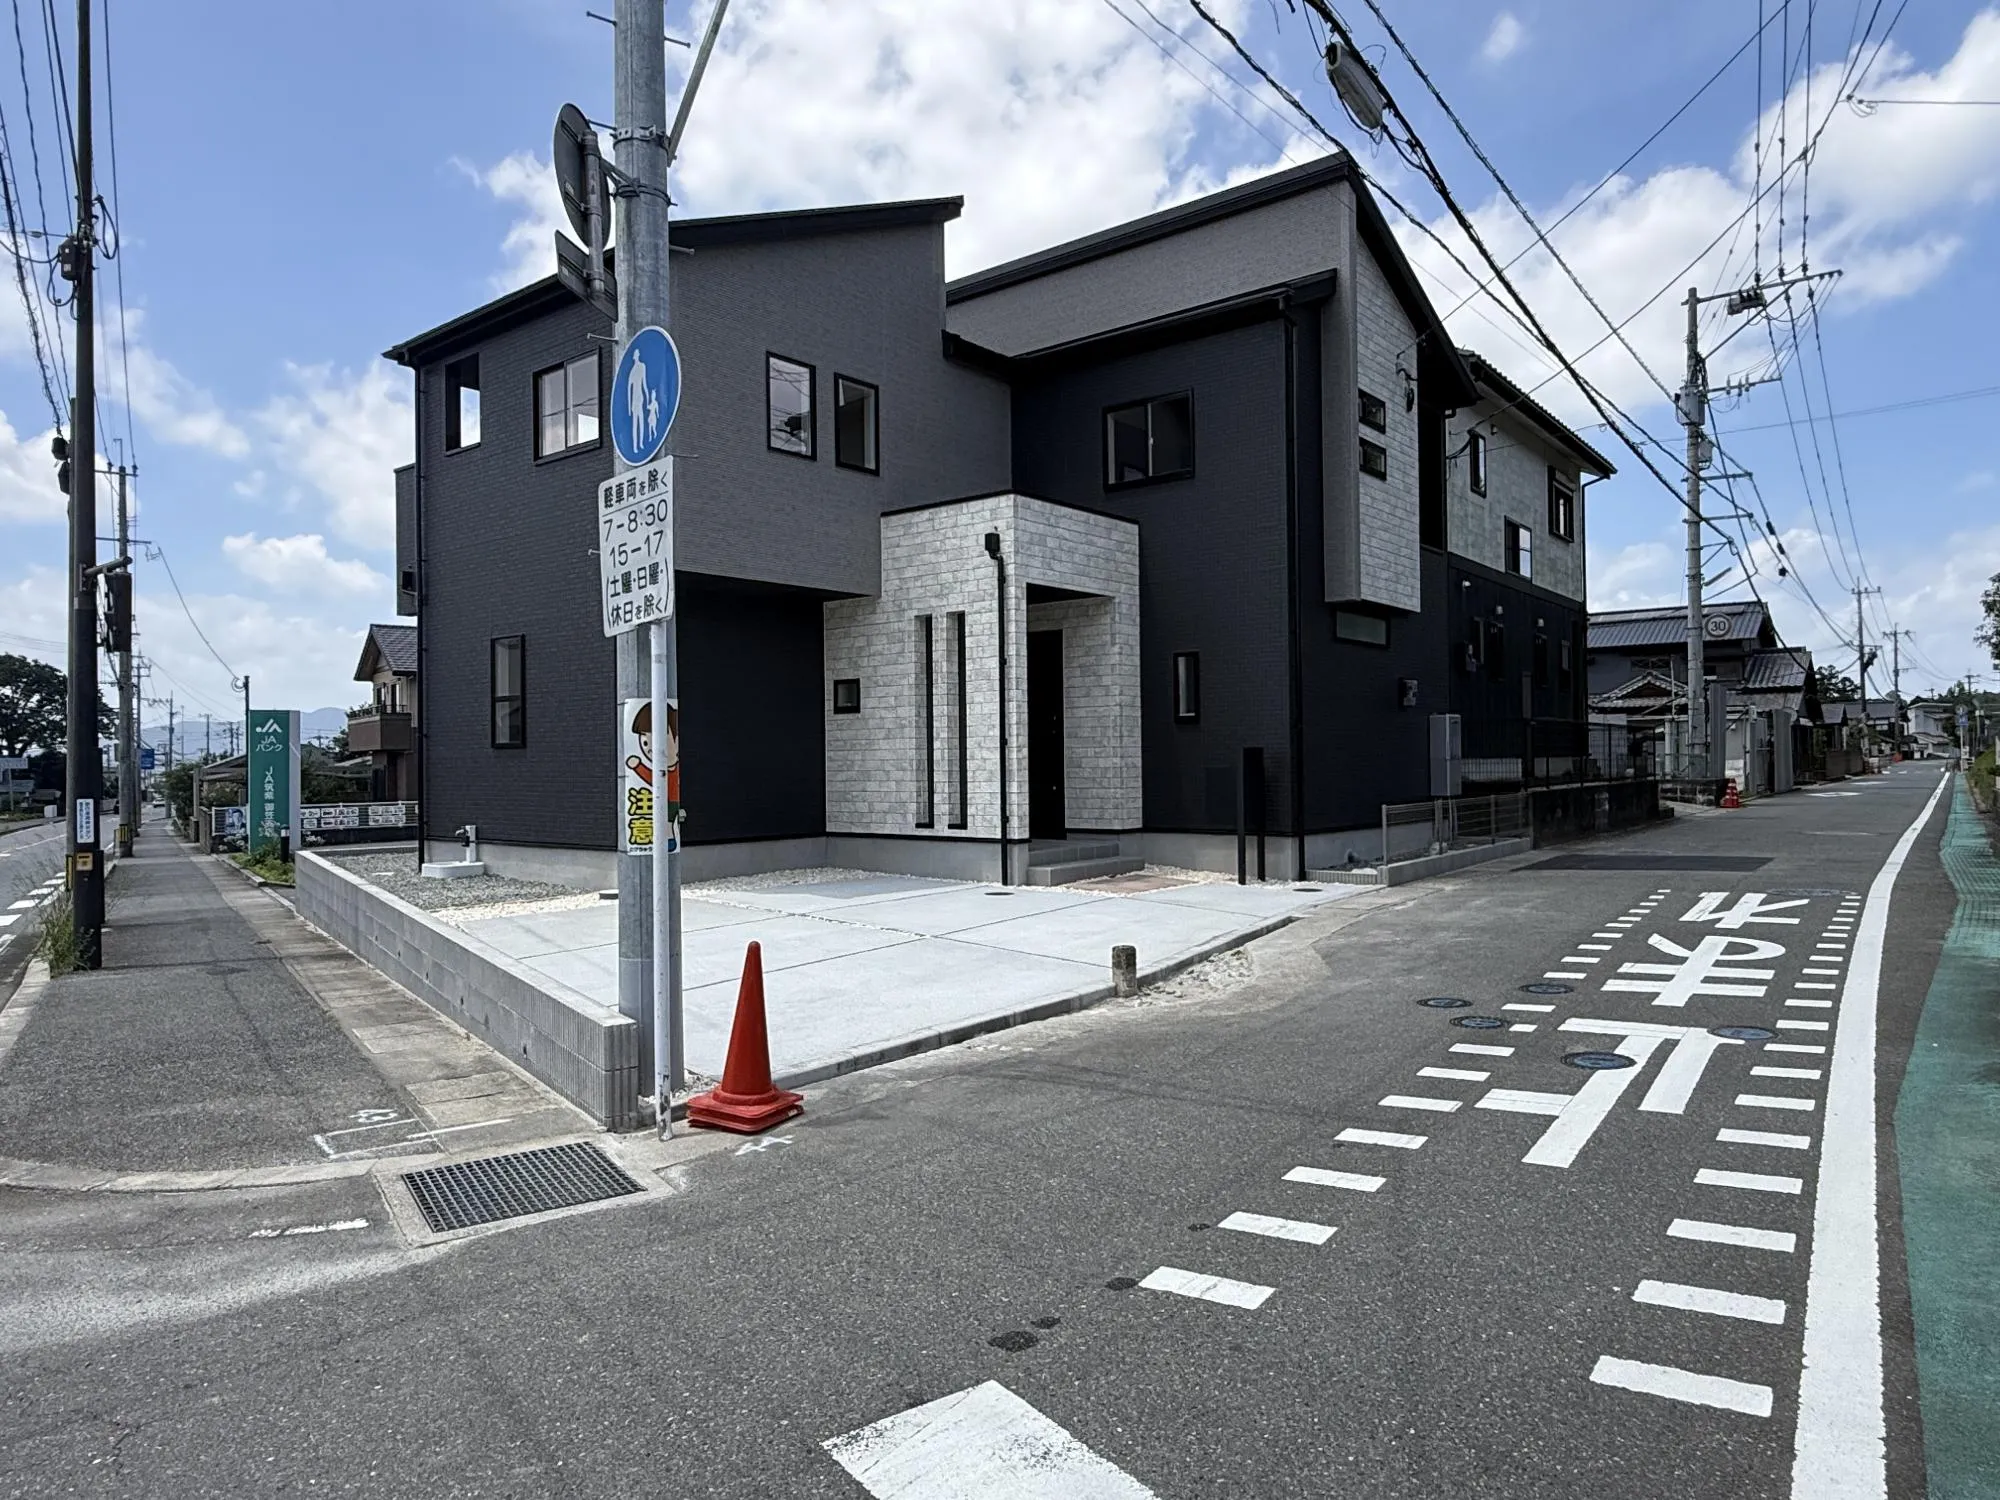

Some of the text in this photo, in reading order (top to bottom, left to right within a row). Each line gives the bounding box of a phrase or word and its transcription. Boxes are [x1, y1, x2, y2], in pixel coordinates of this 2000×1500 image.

[603, 468, 668, 509] 軽車両を除く
[609, 530, 664, 569] 15-17
[1710, 621, 1726, 632] 30
[261, 735, 277, 744] JA
